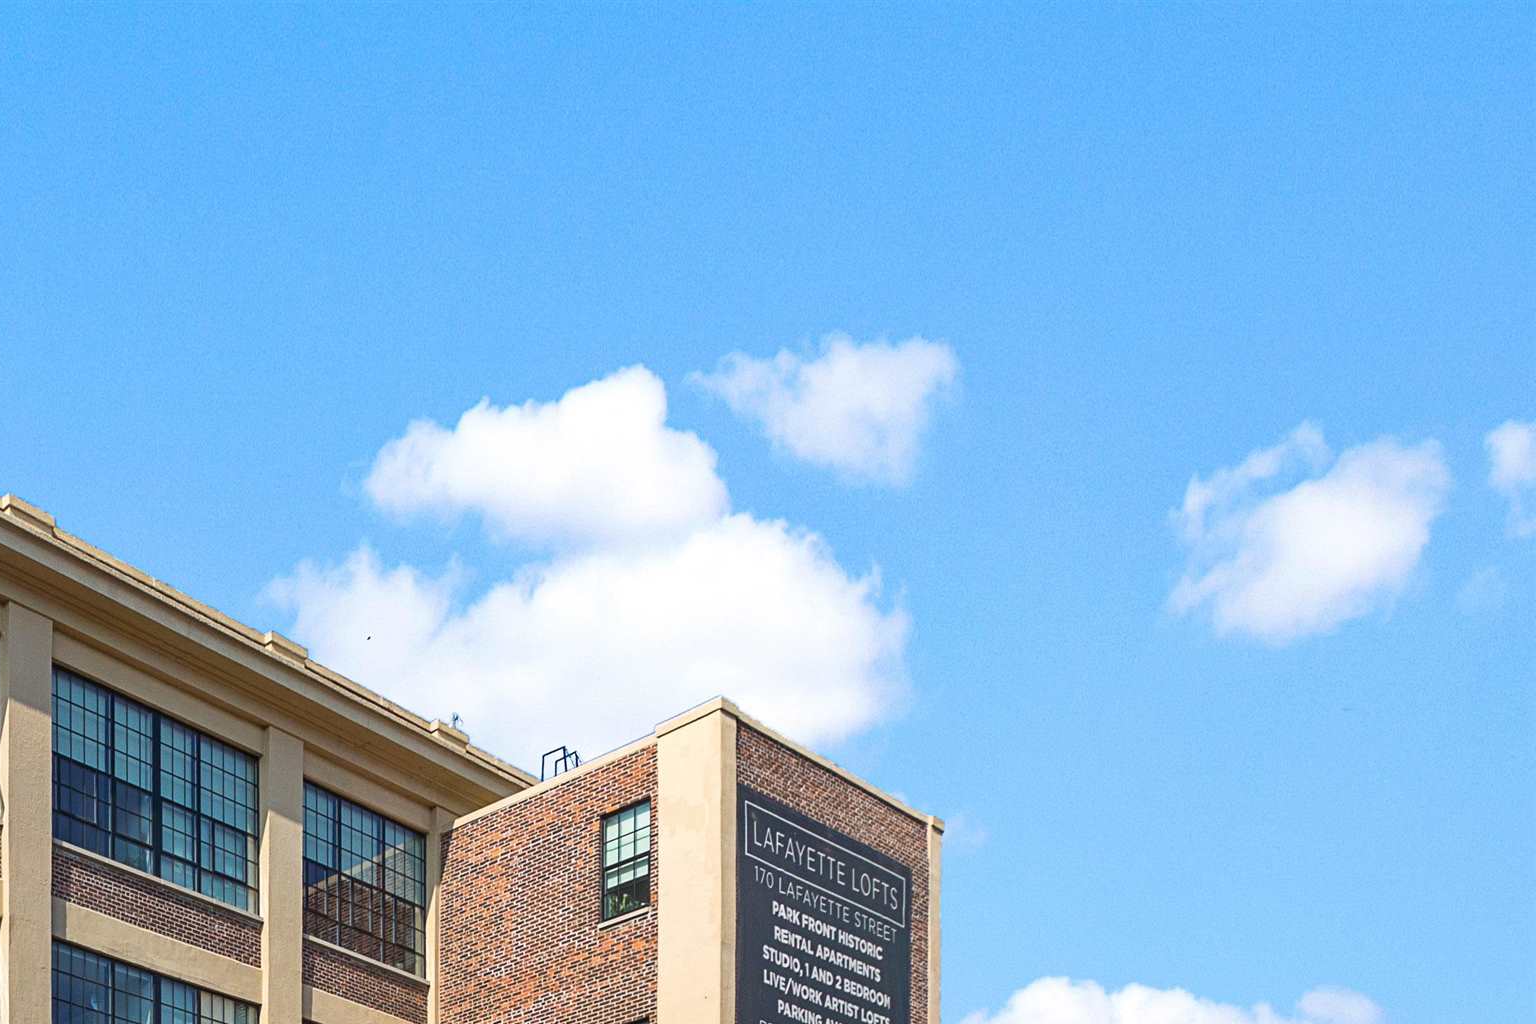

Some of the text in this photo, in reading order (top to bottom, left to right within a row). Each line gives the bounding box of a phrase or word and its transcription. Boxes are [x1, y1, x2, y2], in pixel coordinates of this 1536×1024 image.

[753, 820, 898, 911] LAFAYETTE LOFTS
[754, 865, 897, 944] 170 LAFAYETTE STREET
[772, 900, 883, 960] PARK FRONT HISTORIC
[762, 944, 891, 1010] STUDIO, 1 AND 2 BEDROOM
[774, 925, 881, 983] RENTAL APARTMENTS
[763, 969, 822, 1006] LIVE/WORK
[824, 994, 859, 1019] ARTIST
